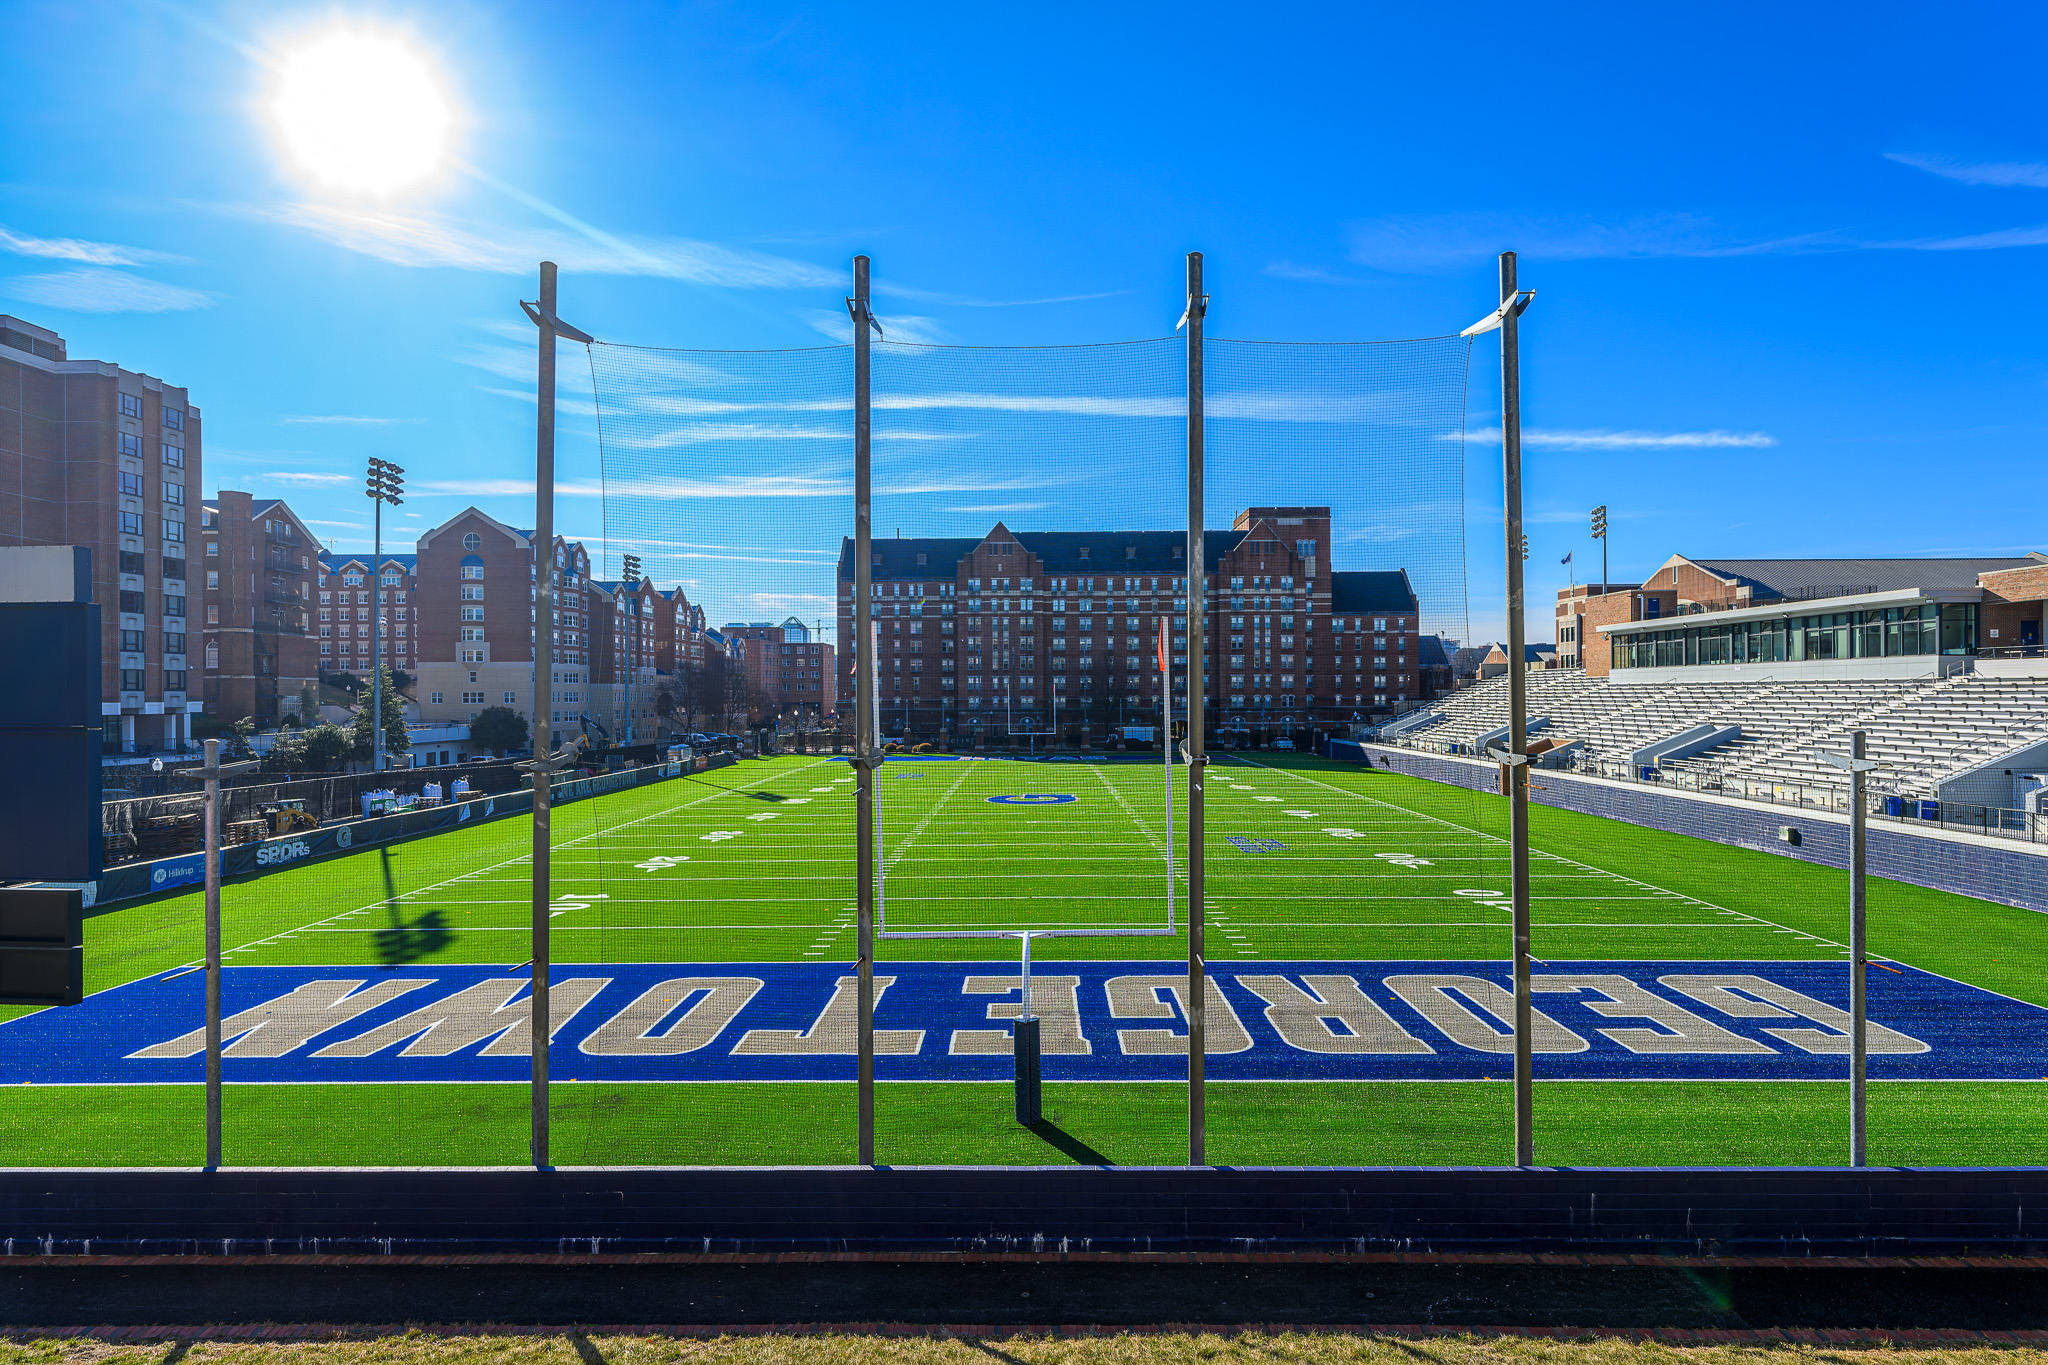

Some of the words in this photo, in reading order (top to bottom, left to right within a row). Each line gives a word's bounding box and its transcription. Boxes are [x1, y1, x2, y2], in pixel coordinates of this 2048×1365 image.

[576, 779, 592, 796] ARE
[593, 770, 637, 793] GEORGETOWN
[336, 826, 353, 848] G
[168, 867, 194, 878] Hilldrup
[634, 856, 690, 868] 20
[124, 974, 1933, 1058] GEORGETOWN
